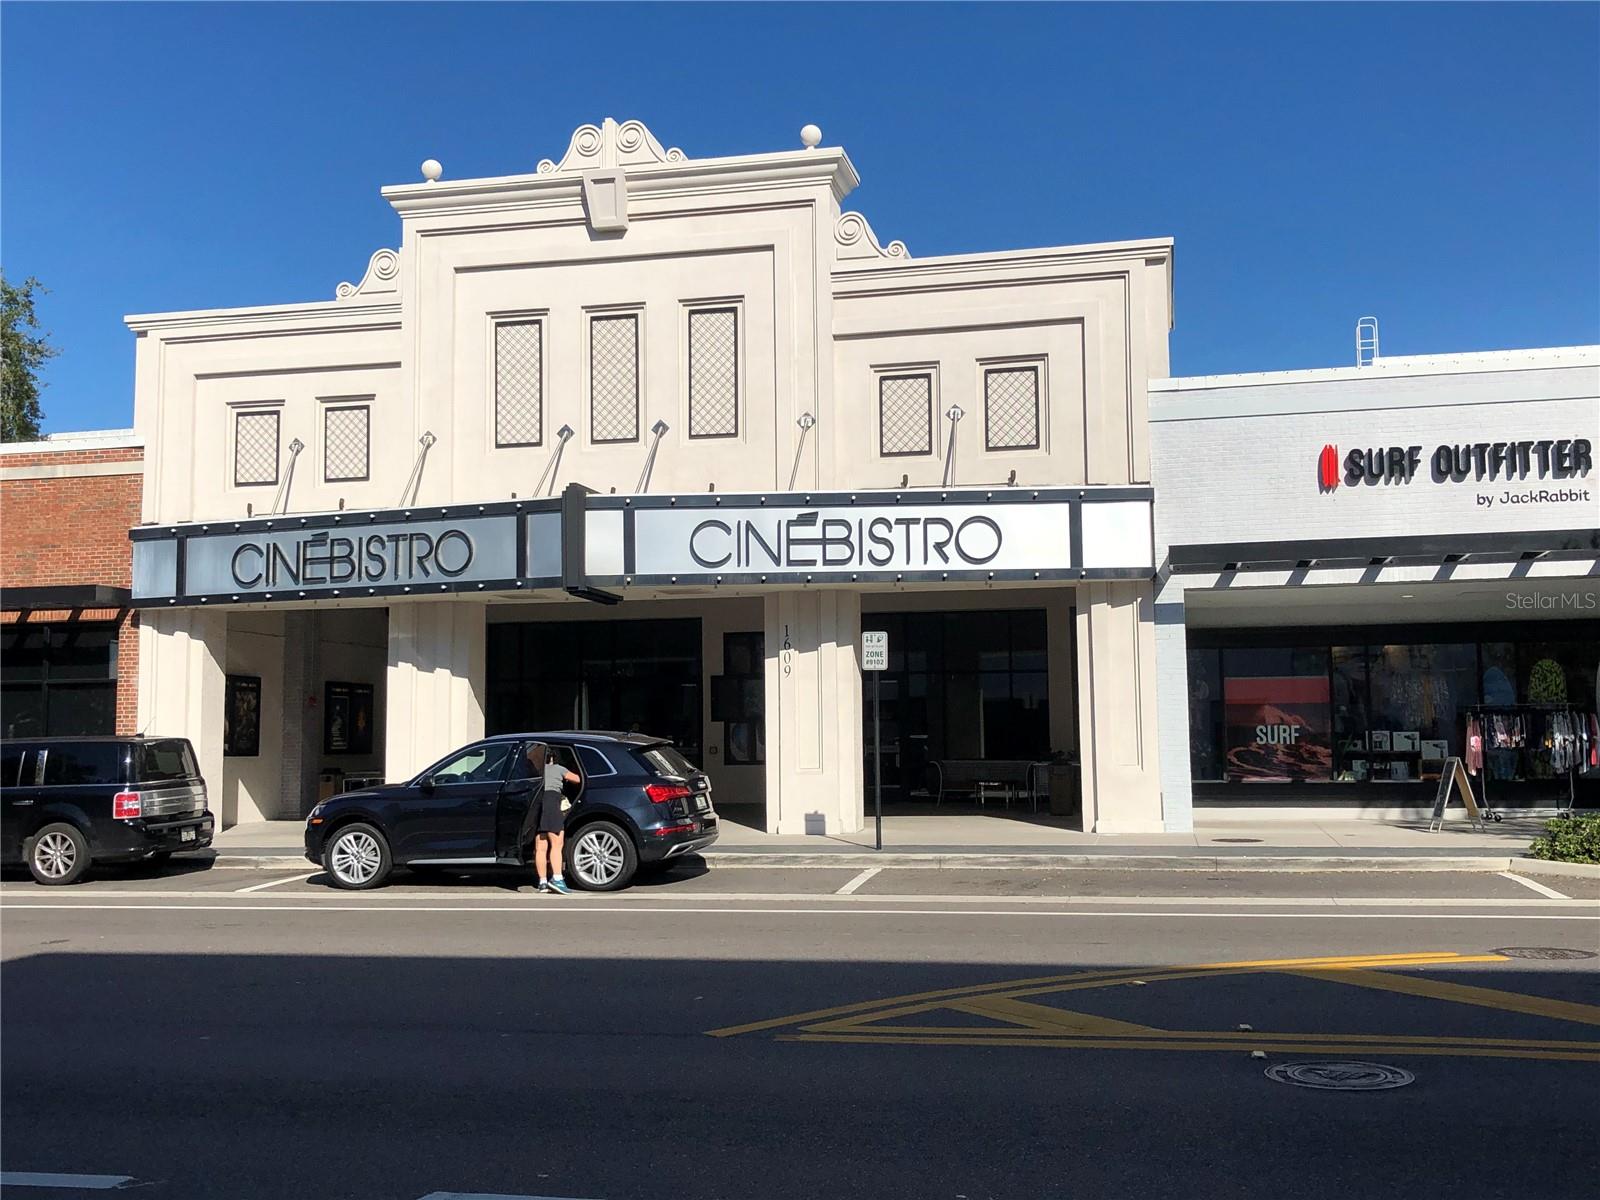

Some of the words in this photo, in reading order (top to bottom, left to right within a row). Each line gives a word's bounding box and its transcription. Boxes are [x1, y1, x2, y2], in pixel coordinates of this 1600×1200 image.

[1346, 445, 1422, 484] SURF
[1434, 439, 1592, 480] OUTFITTER
[1476, 493, 1494, 508] by
[1500, 489, 1590, 504] JackRabbit
[231, 530, 474, 589] CINÉBISTRO
[689, 511, 1003, 568] CINÉBISTRO
[783, 624, 792, 679] 1609
[865, 650, 884, 658] ZONE
[1255, 724, 1300, 745] SURF
